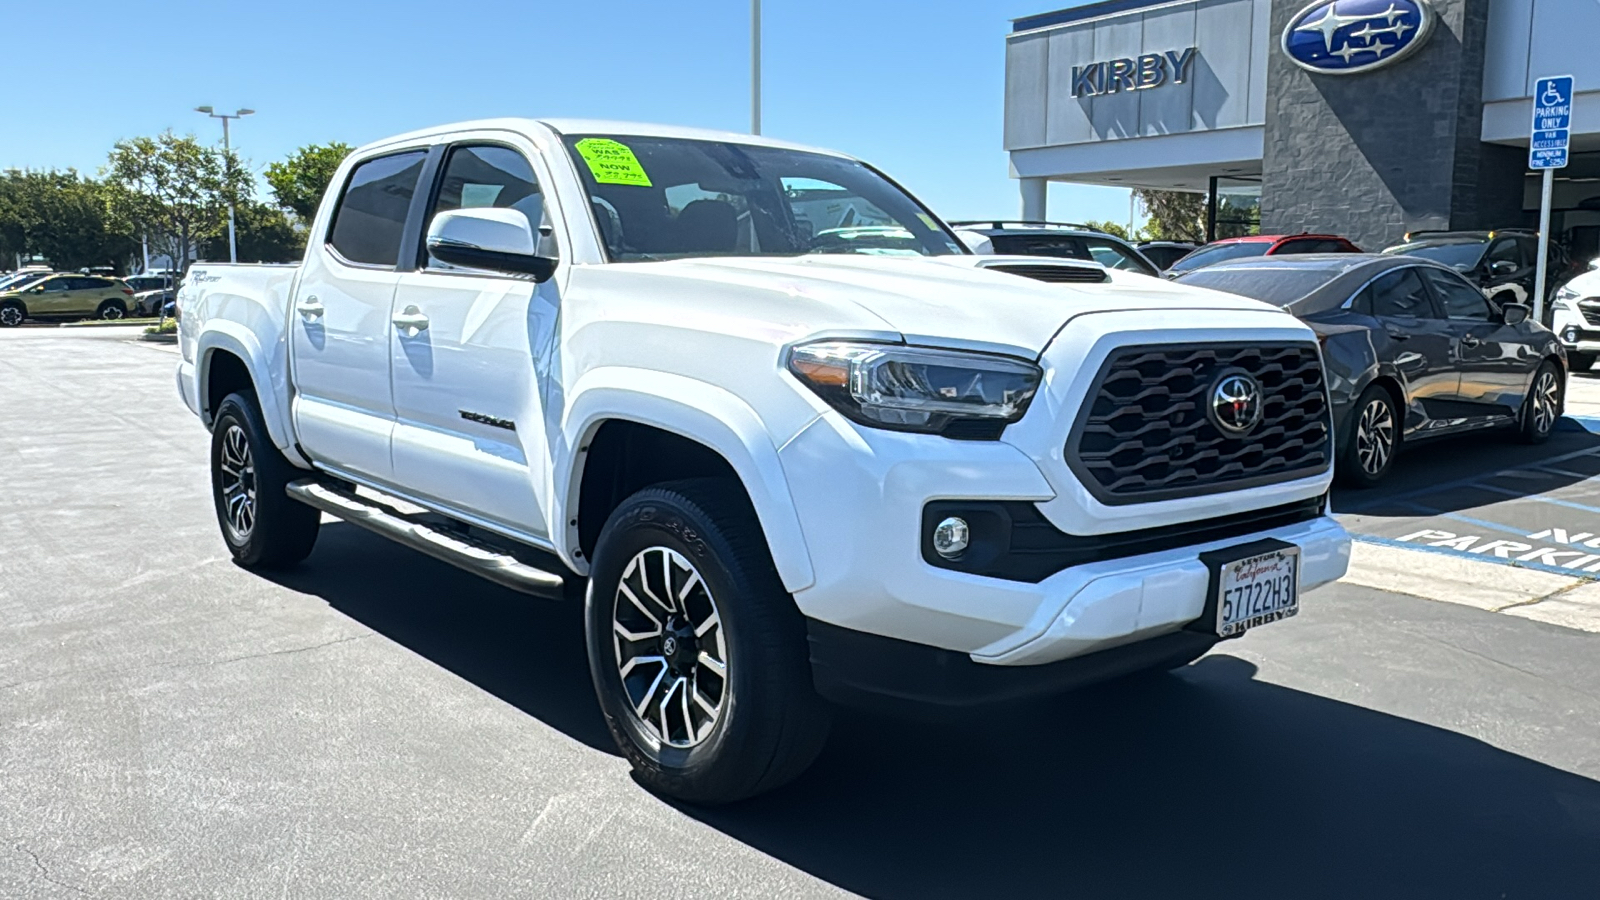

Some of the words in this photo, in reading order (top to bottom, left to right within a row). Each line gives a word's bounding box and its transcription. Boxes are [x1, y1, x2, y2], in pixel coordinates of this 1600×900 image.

[1070, 47, 1197, 98] KIRBY
[1536, 105, 1569, 117] PARKING
[1541, 118, 1561, 128] ONLY
[1533, 139, 1566, 147] ACCESSIBLE
[1536, 150, 1562, 158] MINIMUM
[600, 163, 630, 171] NOW
[1532, 159, 1545, 167] FINE
[1235, 562, 1282, 582] California
[1223, 575, 1291, 621] 57722H3
[1236, 609, 1286, 632] KIRBY
